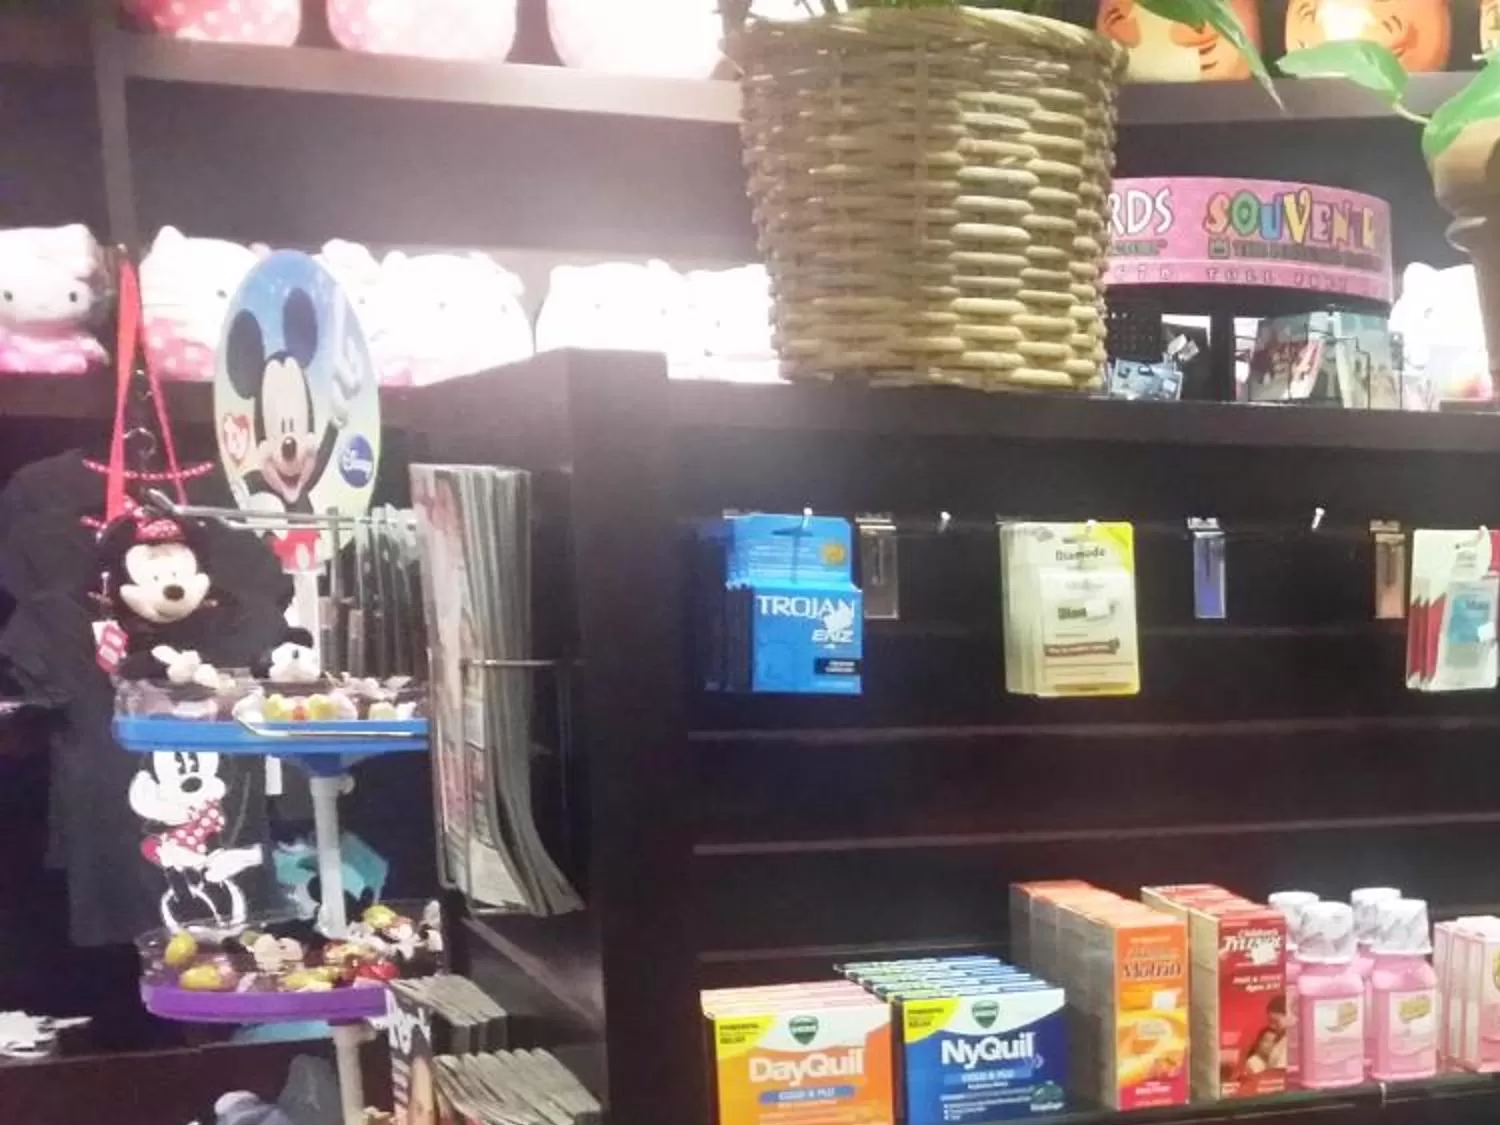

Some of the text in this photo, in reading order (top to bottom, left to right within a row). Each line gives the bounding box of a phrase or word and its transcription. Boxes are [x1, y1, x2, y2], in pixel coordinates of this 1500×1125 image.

[756, 594, 856, 619] TROJAN
[748, 1048, 865, 1087] DayQuil
[941, 1032, 1036, 1071] NyQuil
